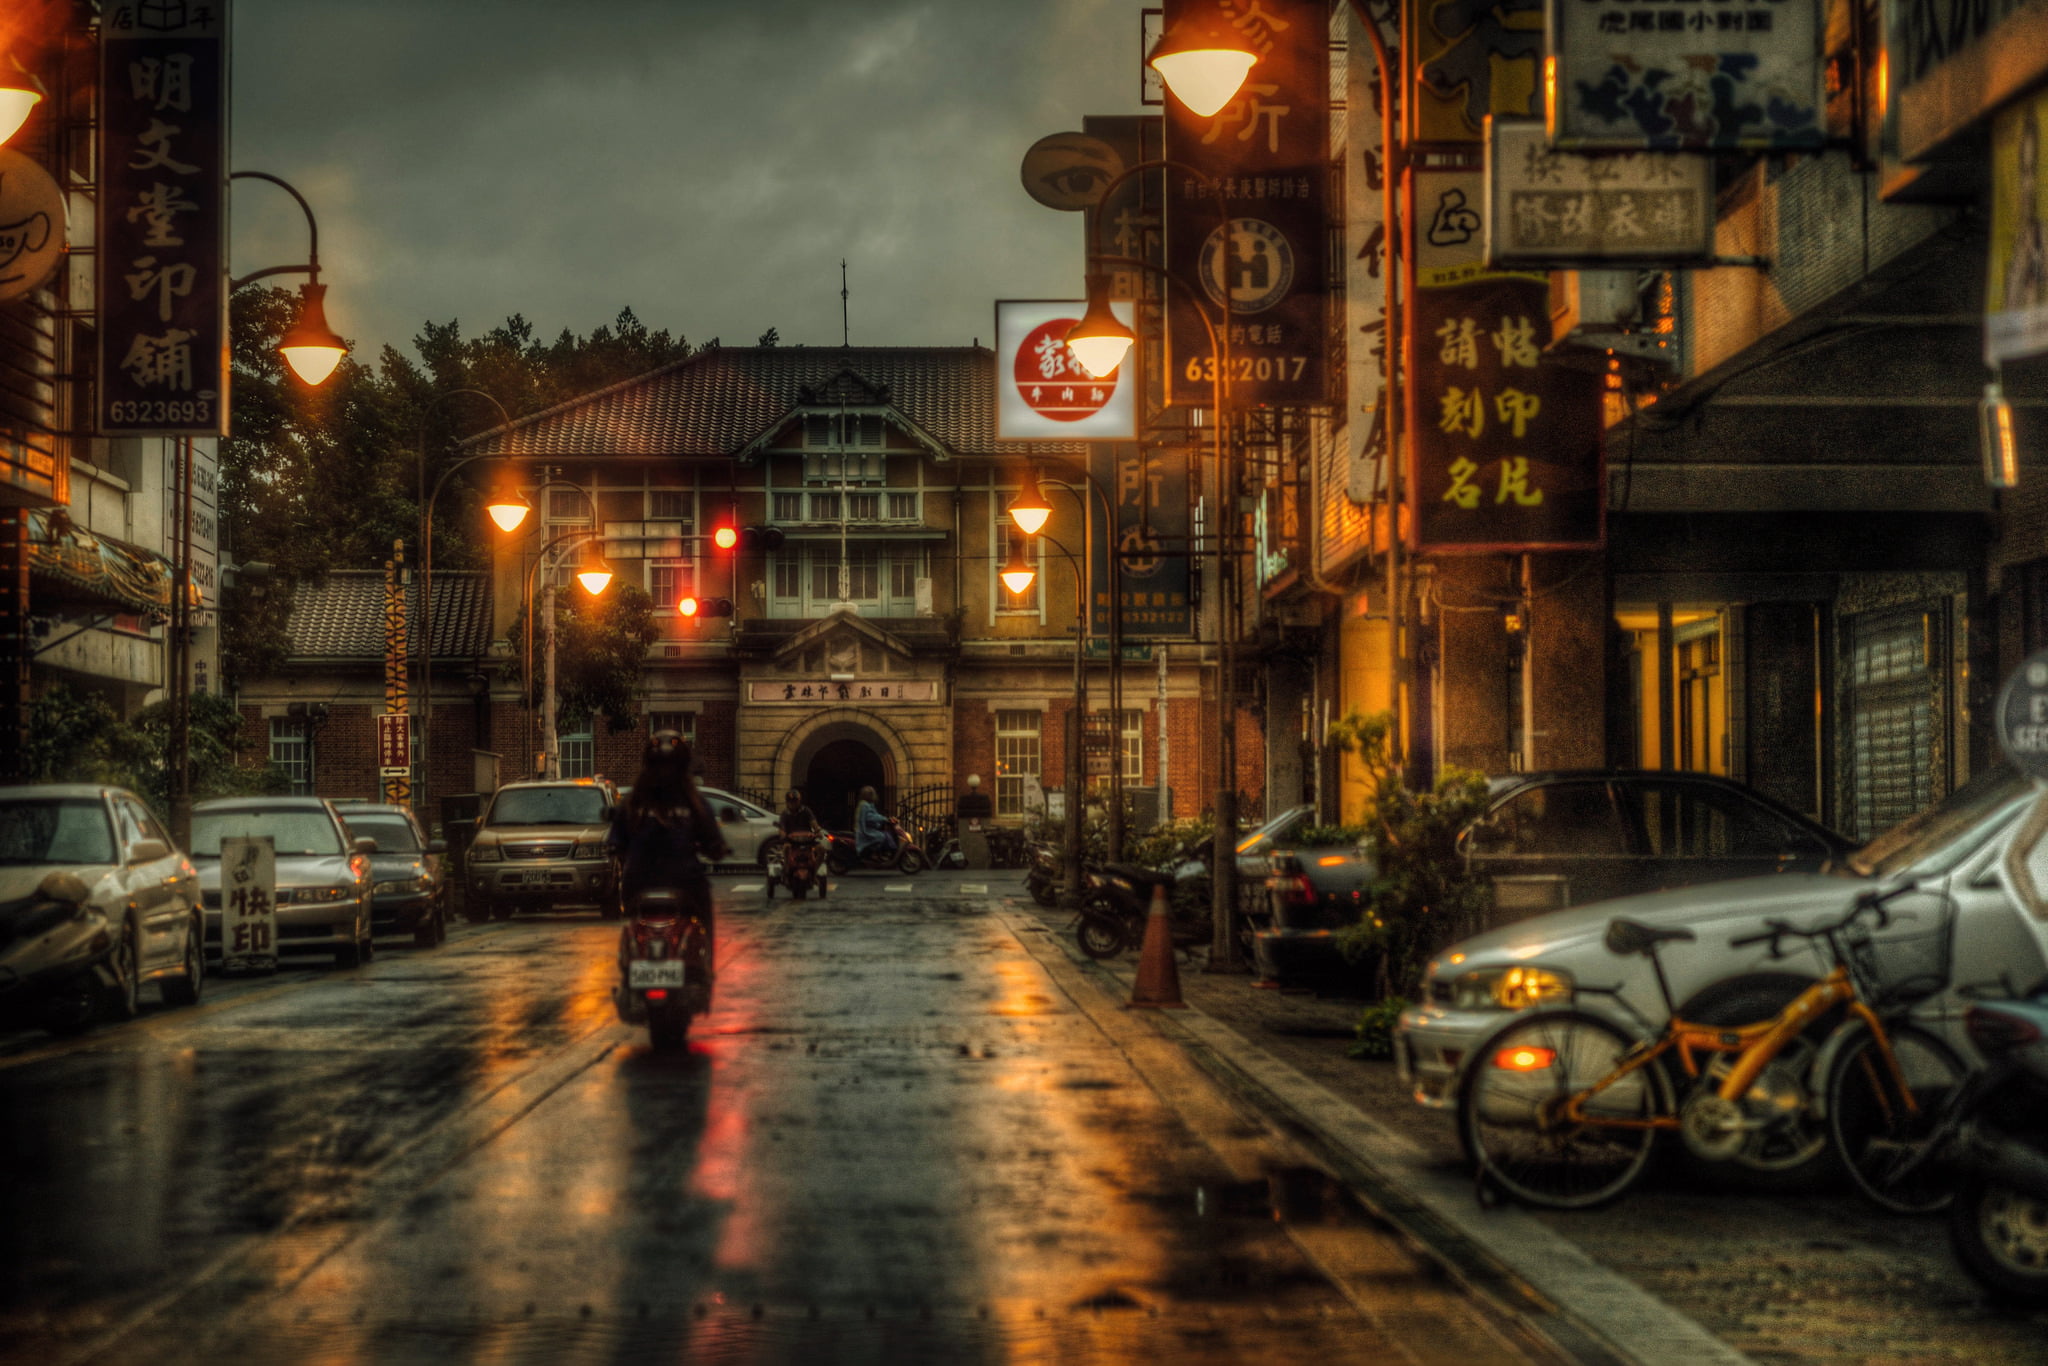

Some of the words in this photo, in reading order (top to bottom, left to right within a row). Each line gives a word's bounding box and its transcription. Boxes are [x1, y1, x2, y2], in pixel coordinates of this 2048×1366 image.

[110, 401, 209, 423] 6323693
[1438, 386, 1541, 439] 刻印
[1441, 456, 1544, 509] 名片
